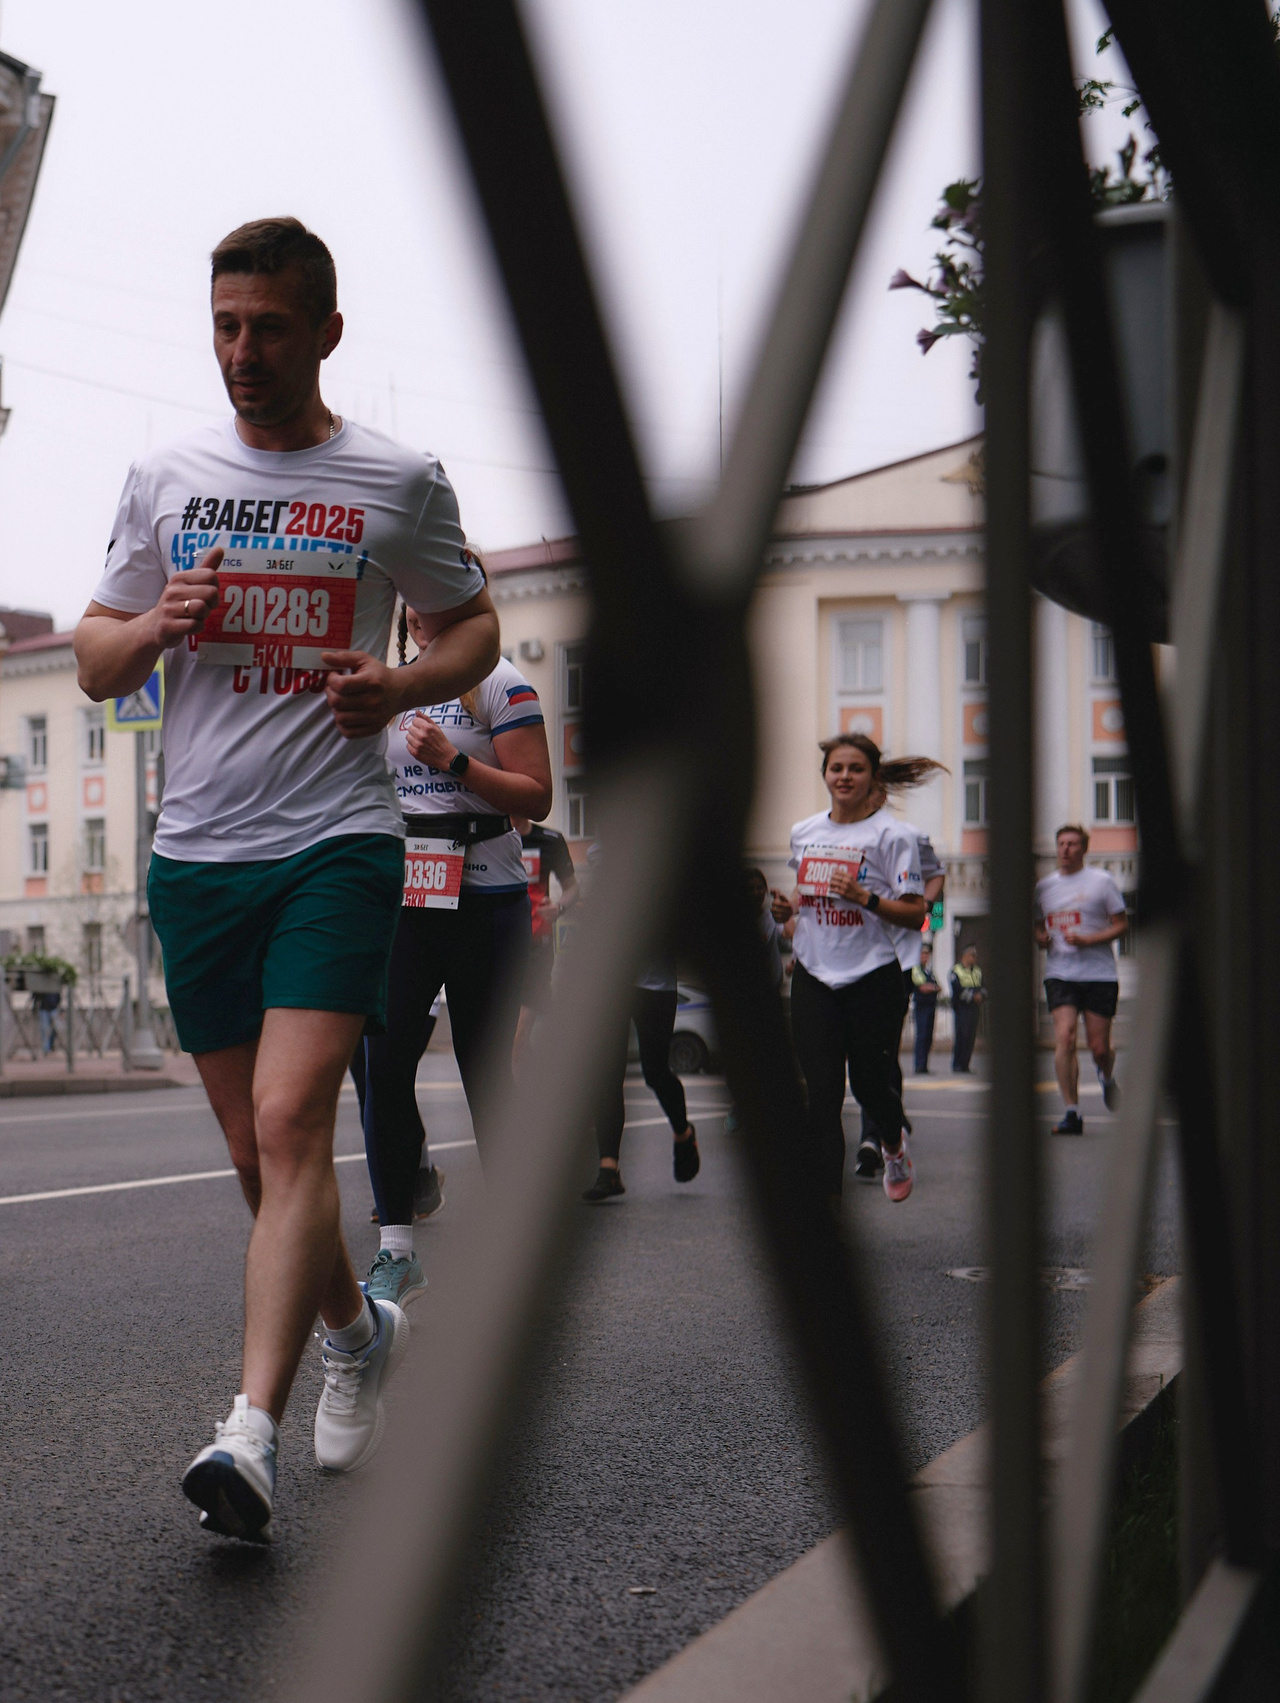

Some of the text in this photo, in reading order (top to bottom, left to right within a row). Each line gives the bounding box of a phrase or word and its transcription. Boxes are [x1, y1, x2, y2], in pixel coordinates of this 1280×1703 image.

[181, 497, 365, 545] #ЗАБЕГ2025
[223, 558, 242, 568] ПСБ
[222, 585, 330, 638] 20283
[404, 860, 447, 890] 0336
[805, 861, 848, 883] 200
